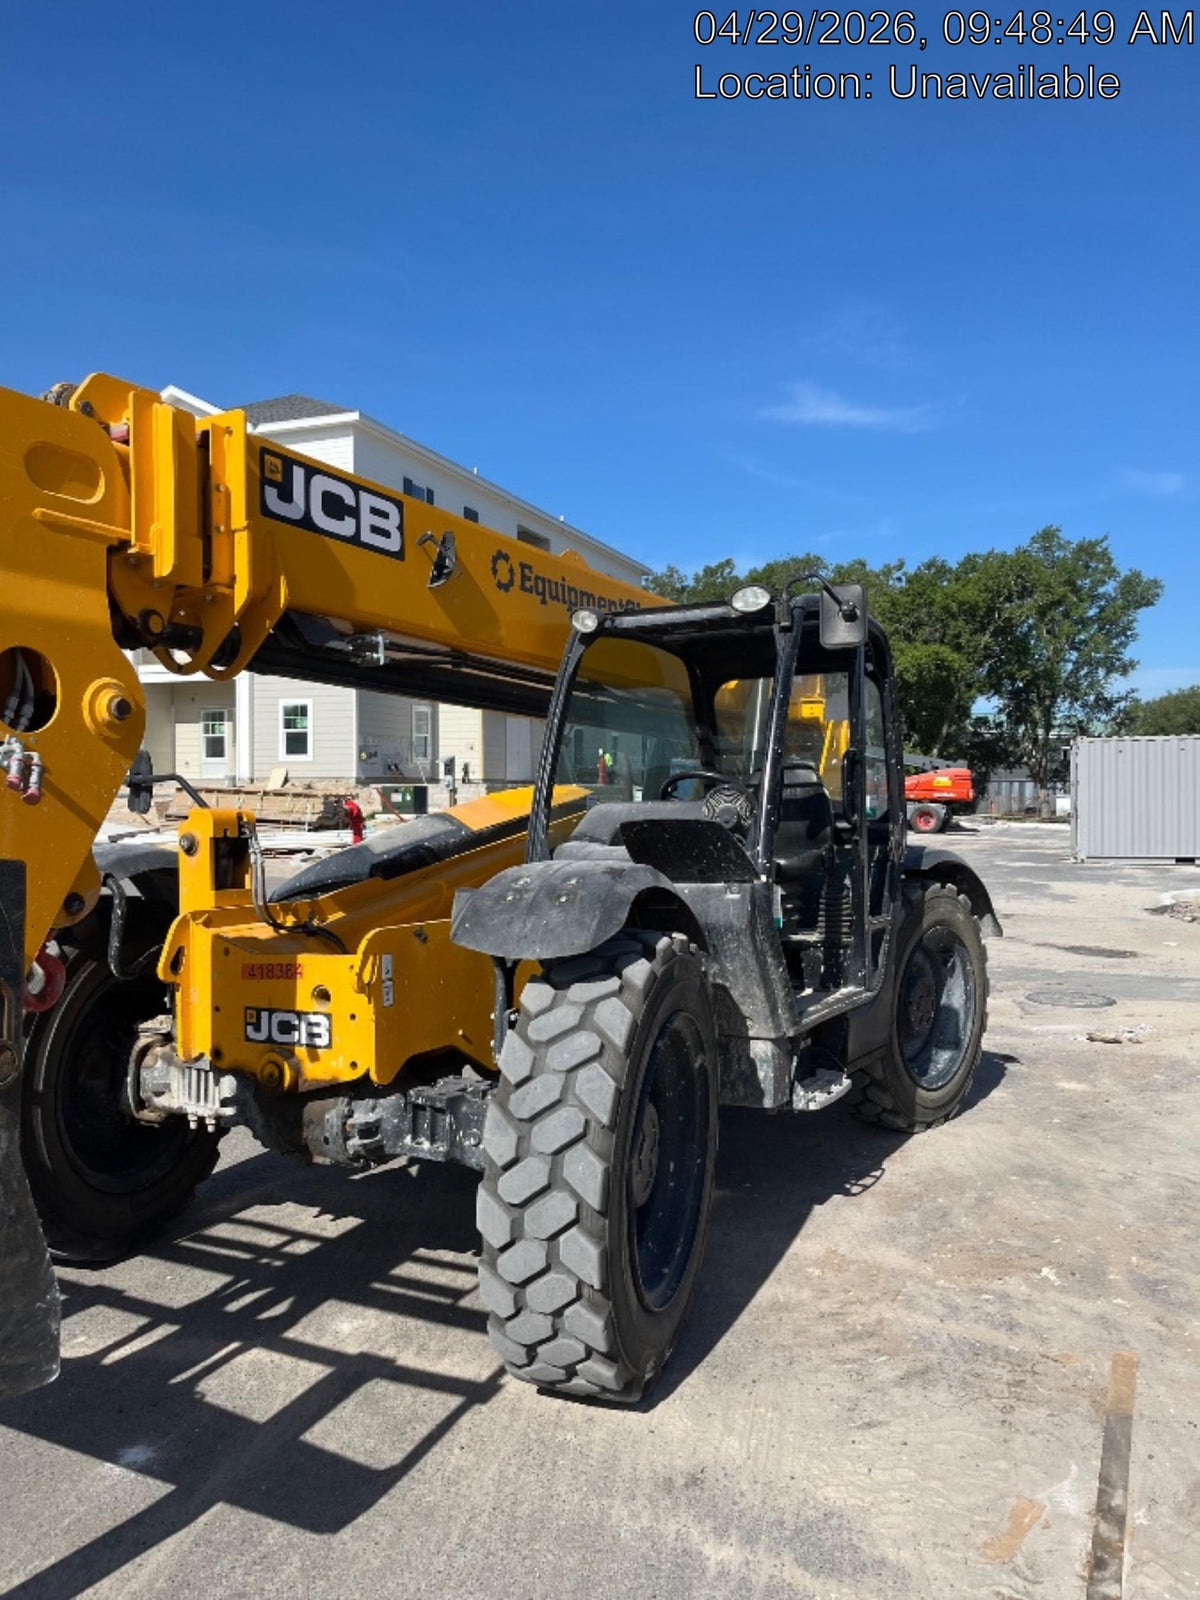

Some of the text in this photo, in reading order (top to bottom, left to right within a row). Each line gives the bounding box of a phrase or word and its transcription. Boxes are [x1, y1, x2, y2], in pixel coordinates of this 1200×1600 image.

[264, 465, 402, 552] JCB
[519, 561, 641, 613] Equipment
[246, 1010, 330, 1047] JCB
